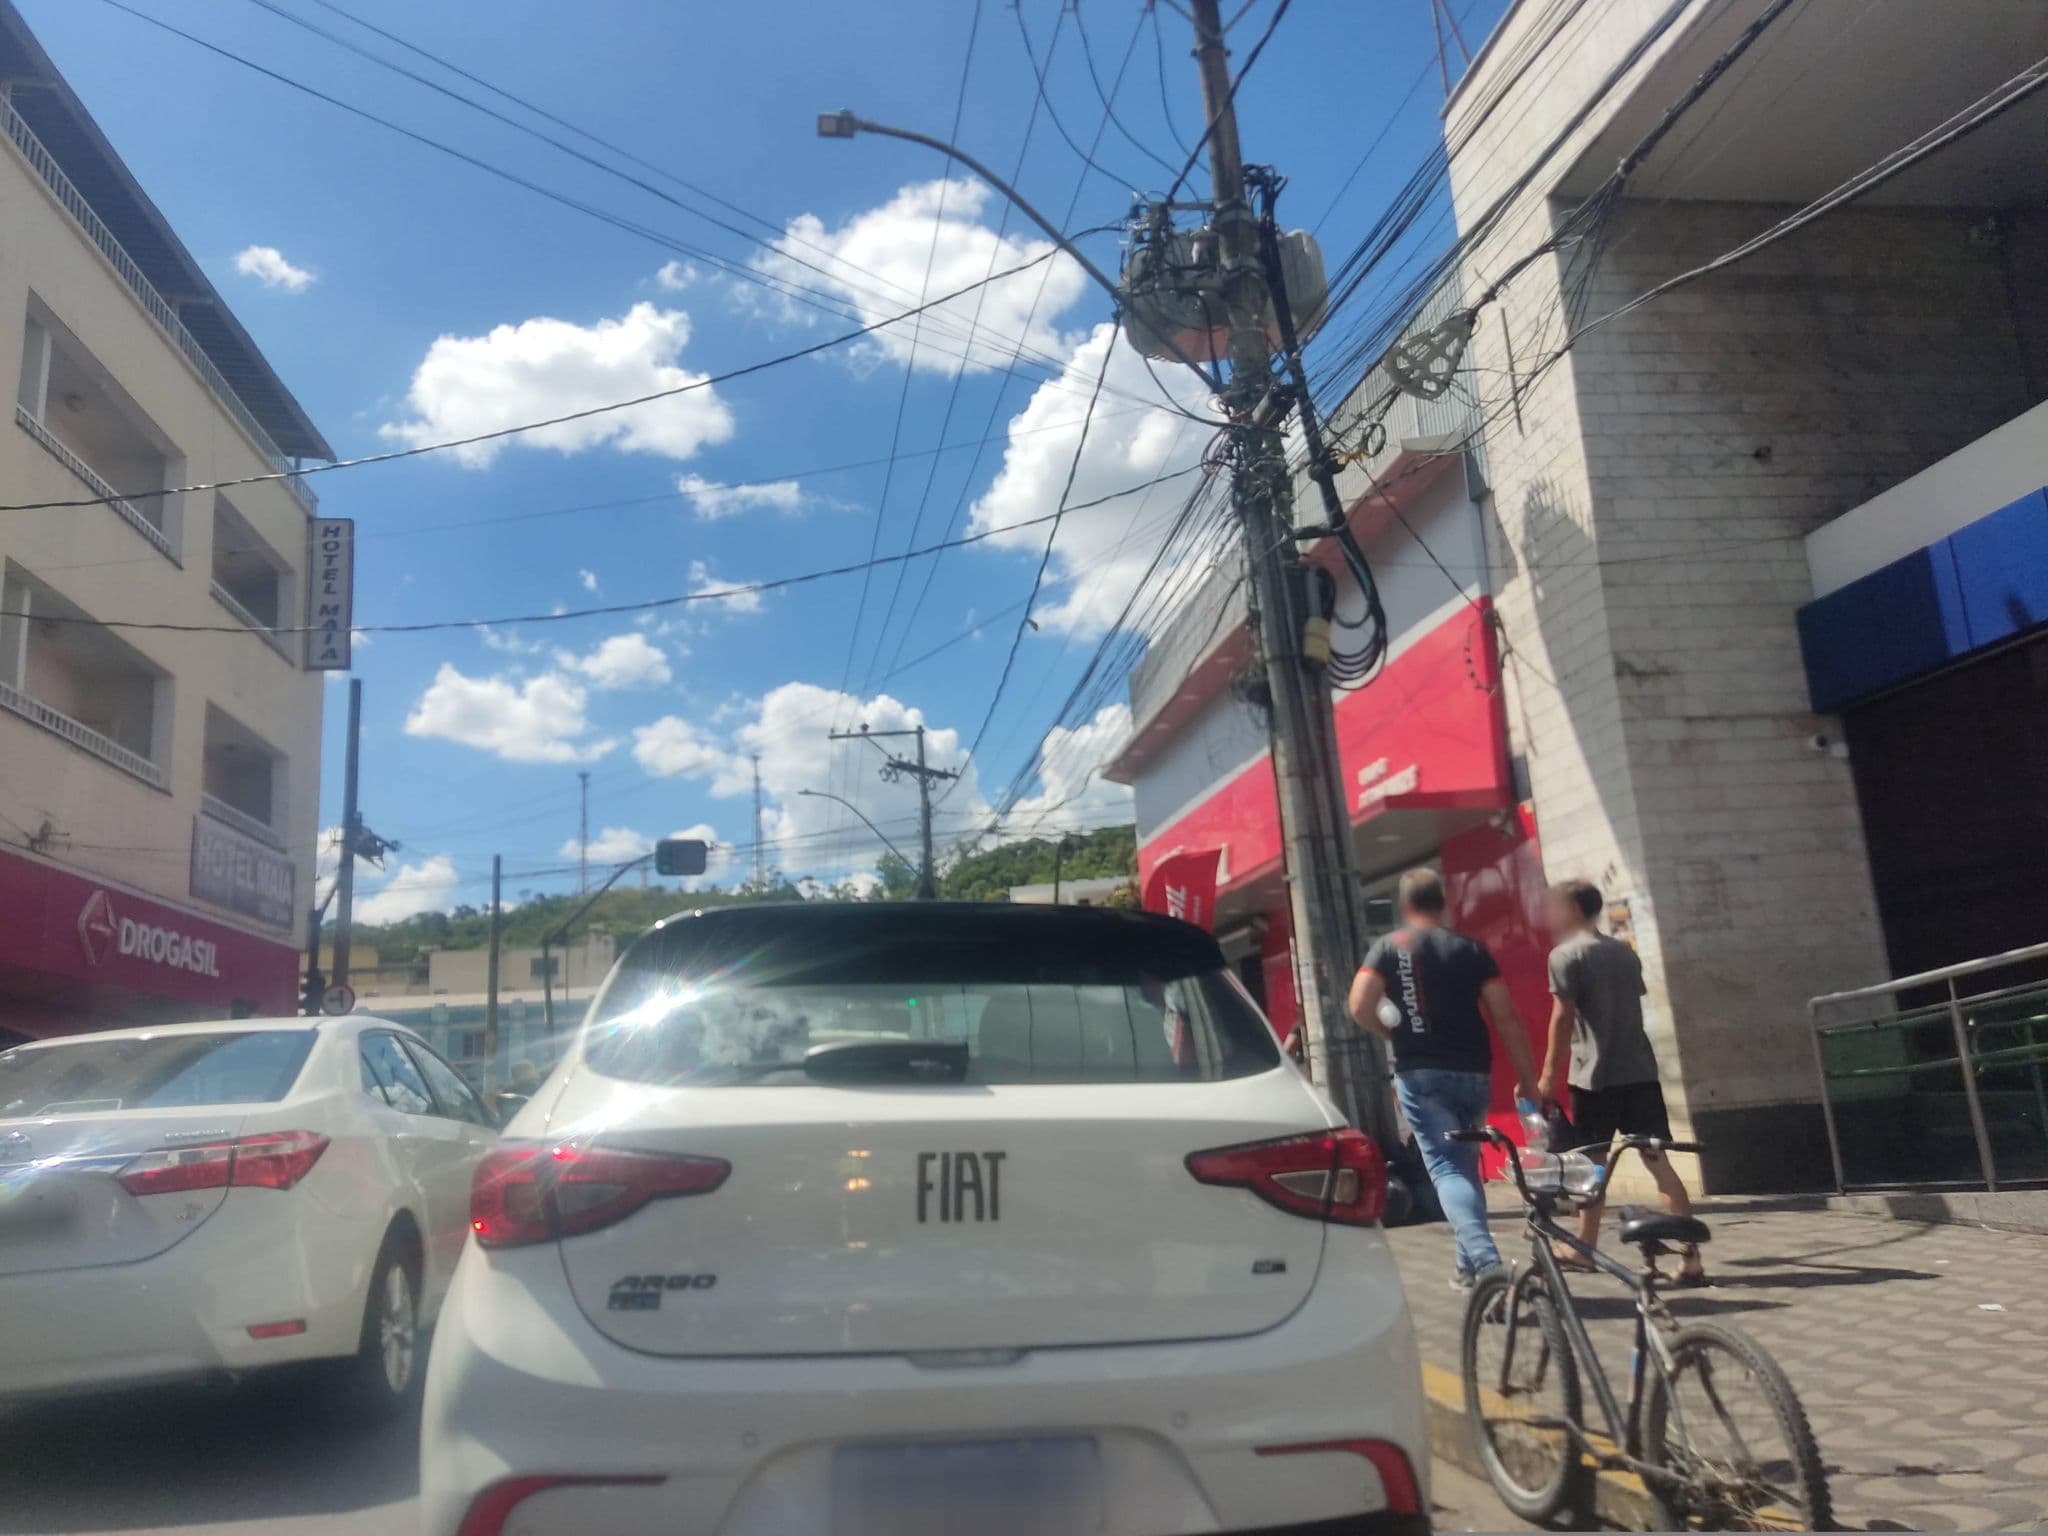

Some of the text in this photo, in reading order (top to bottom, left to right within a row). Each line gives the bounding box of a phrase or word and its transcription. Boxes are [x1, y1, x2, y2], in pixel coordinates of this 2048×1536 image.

[319, 525, 341, 661] HOTEL MAIA
[199, 837, 256, 890] HOTEL
[119, 917, 219, 977] DROGASIL
[917, 1151, 1006, 1222] FIAT
[610, 1274, 717, 1291] ARGO
